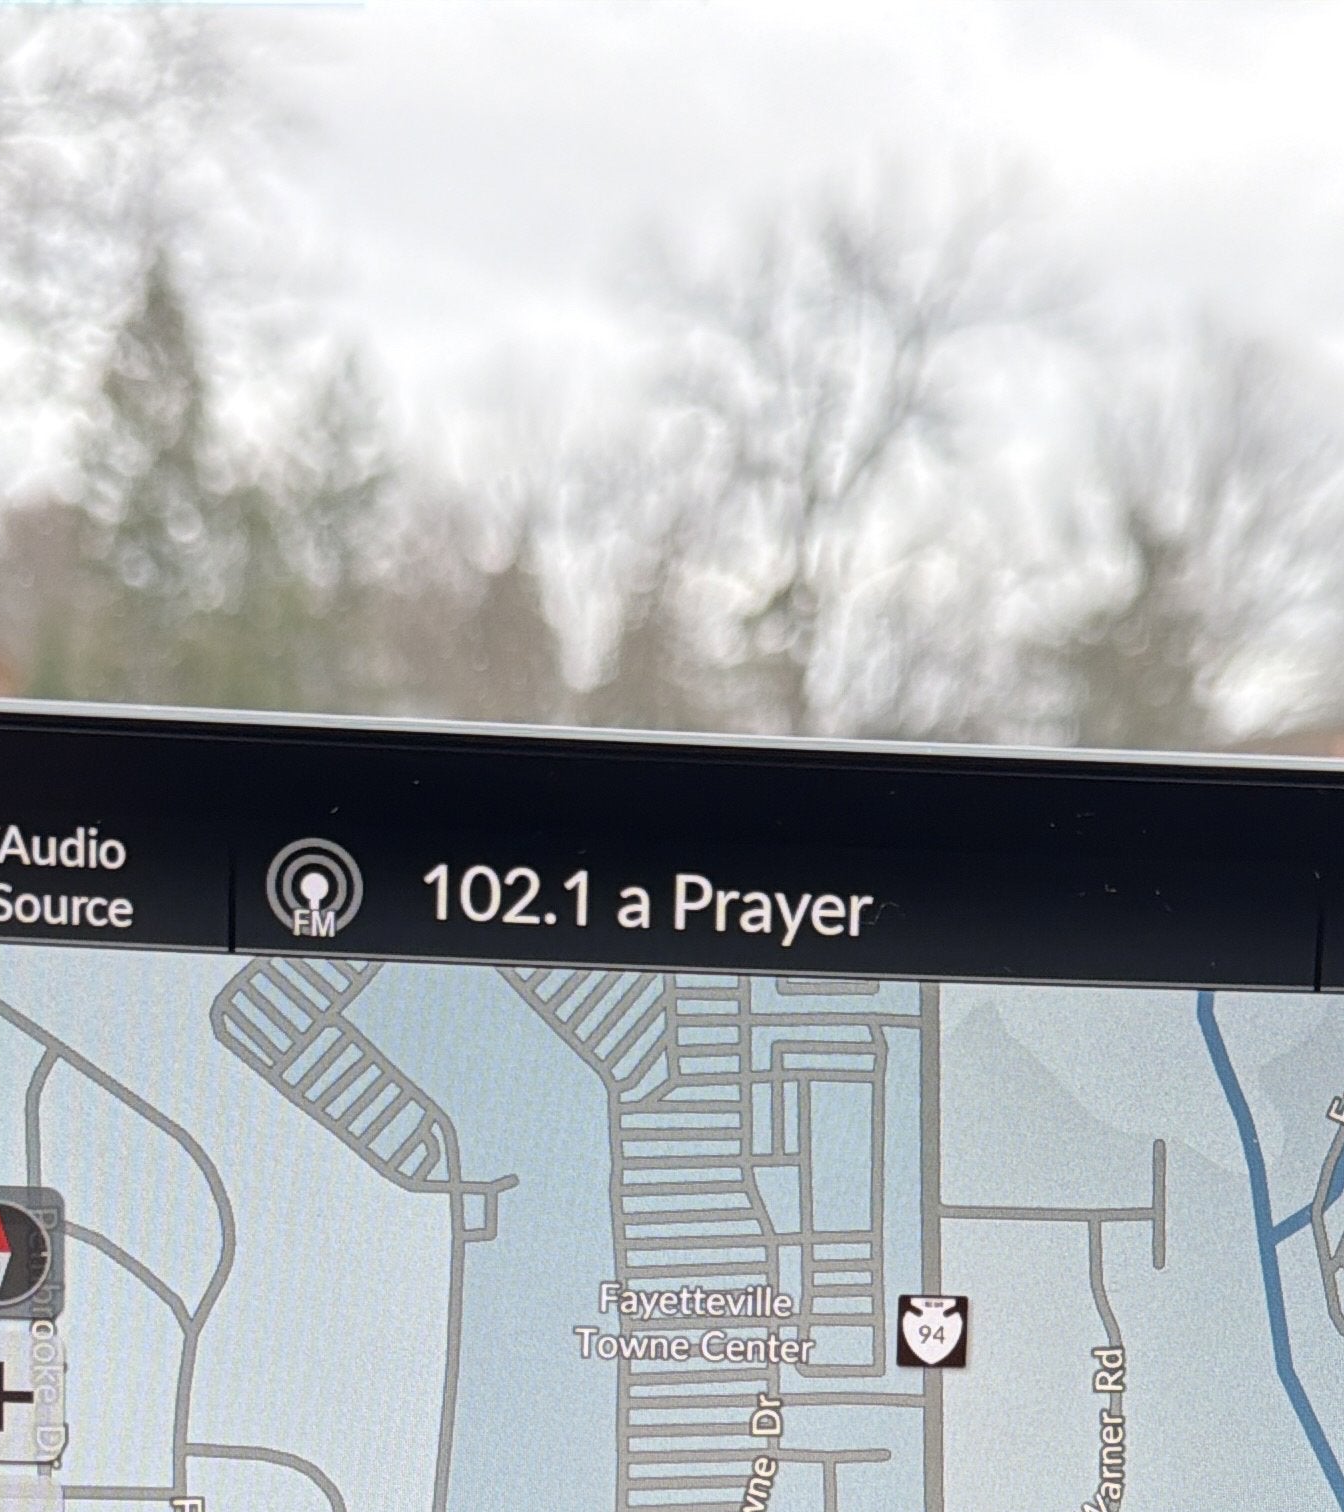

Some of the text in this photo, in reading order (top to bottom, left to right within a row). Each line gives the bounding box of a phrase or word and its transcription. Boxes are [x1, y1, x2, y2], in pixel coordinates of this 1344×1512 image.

[292, 908, 336, 938] FM
[423, 863, 875, 947] 102.1 a Prayer
[598, 1282, 793, 1321] Fayetteville
[574, 1327, 815, 1365] Towne Center
[918, 1324, 946, 1345] 94
[1093, 1348, 1124, 1392] Rd
[751, 1393, 782, 1437] Dr
